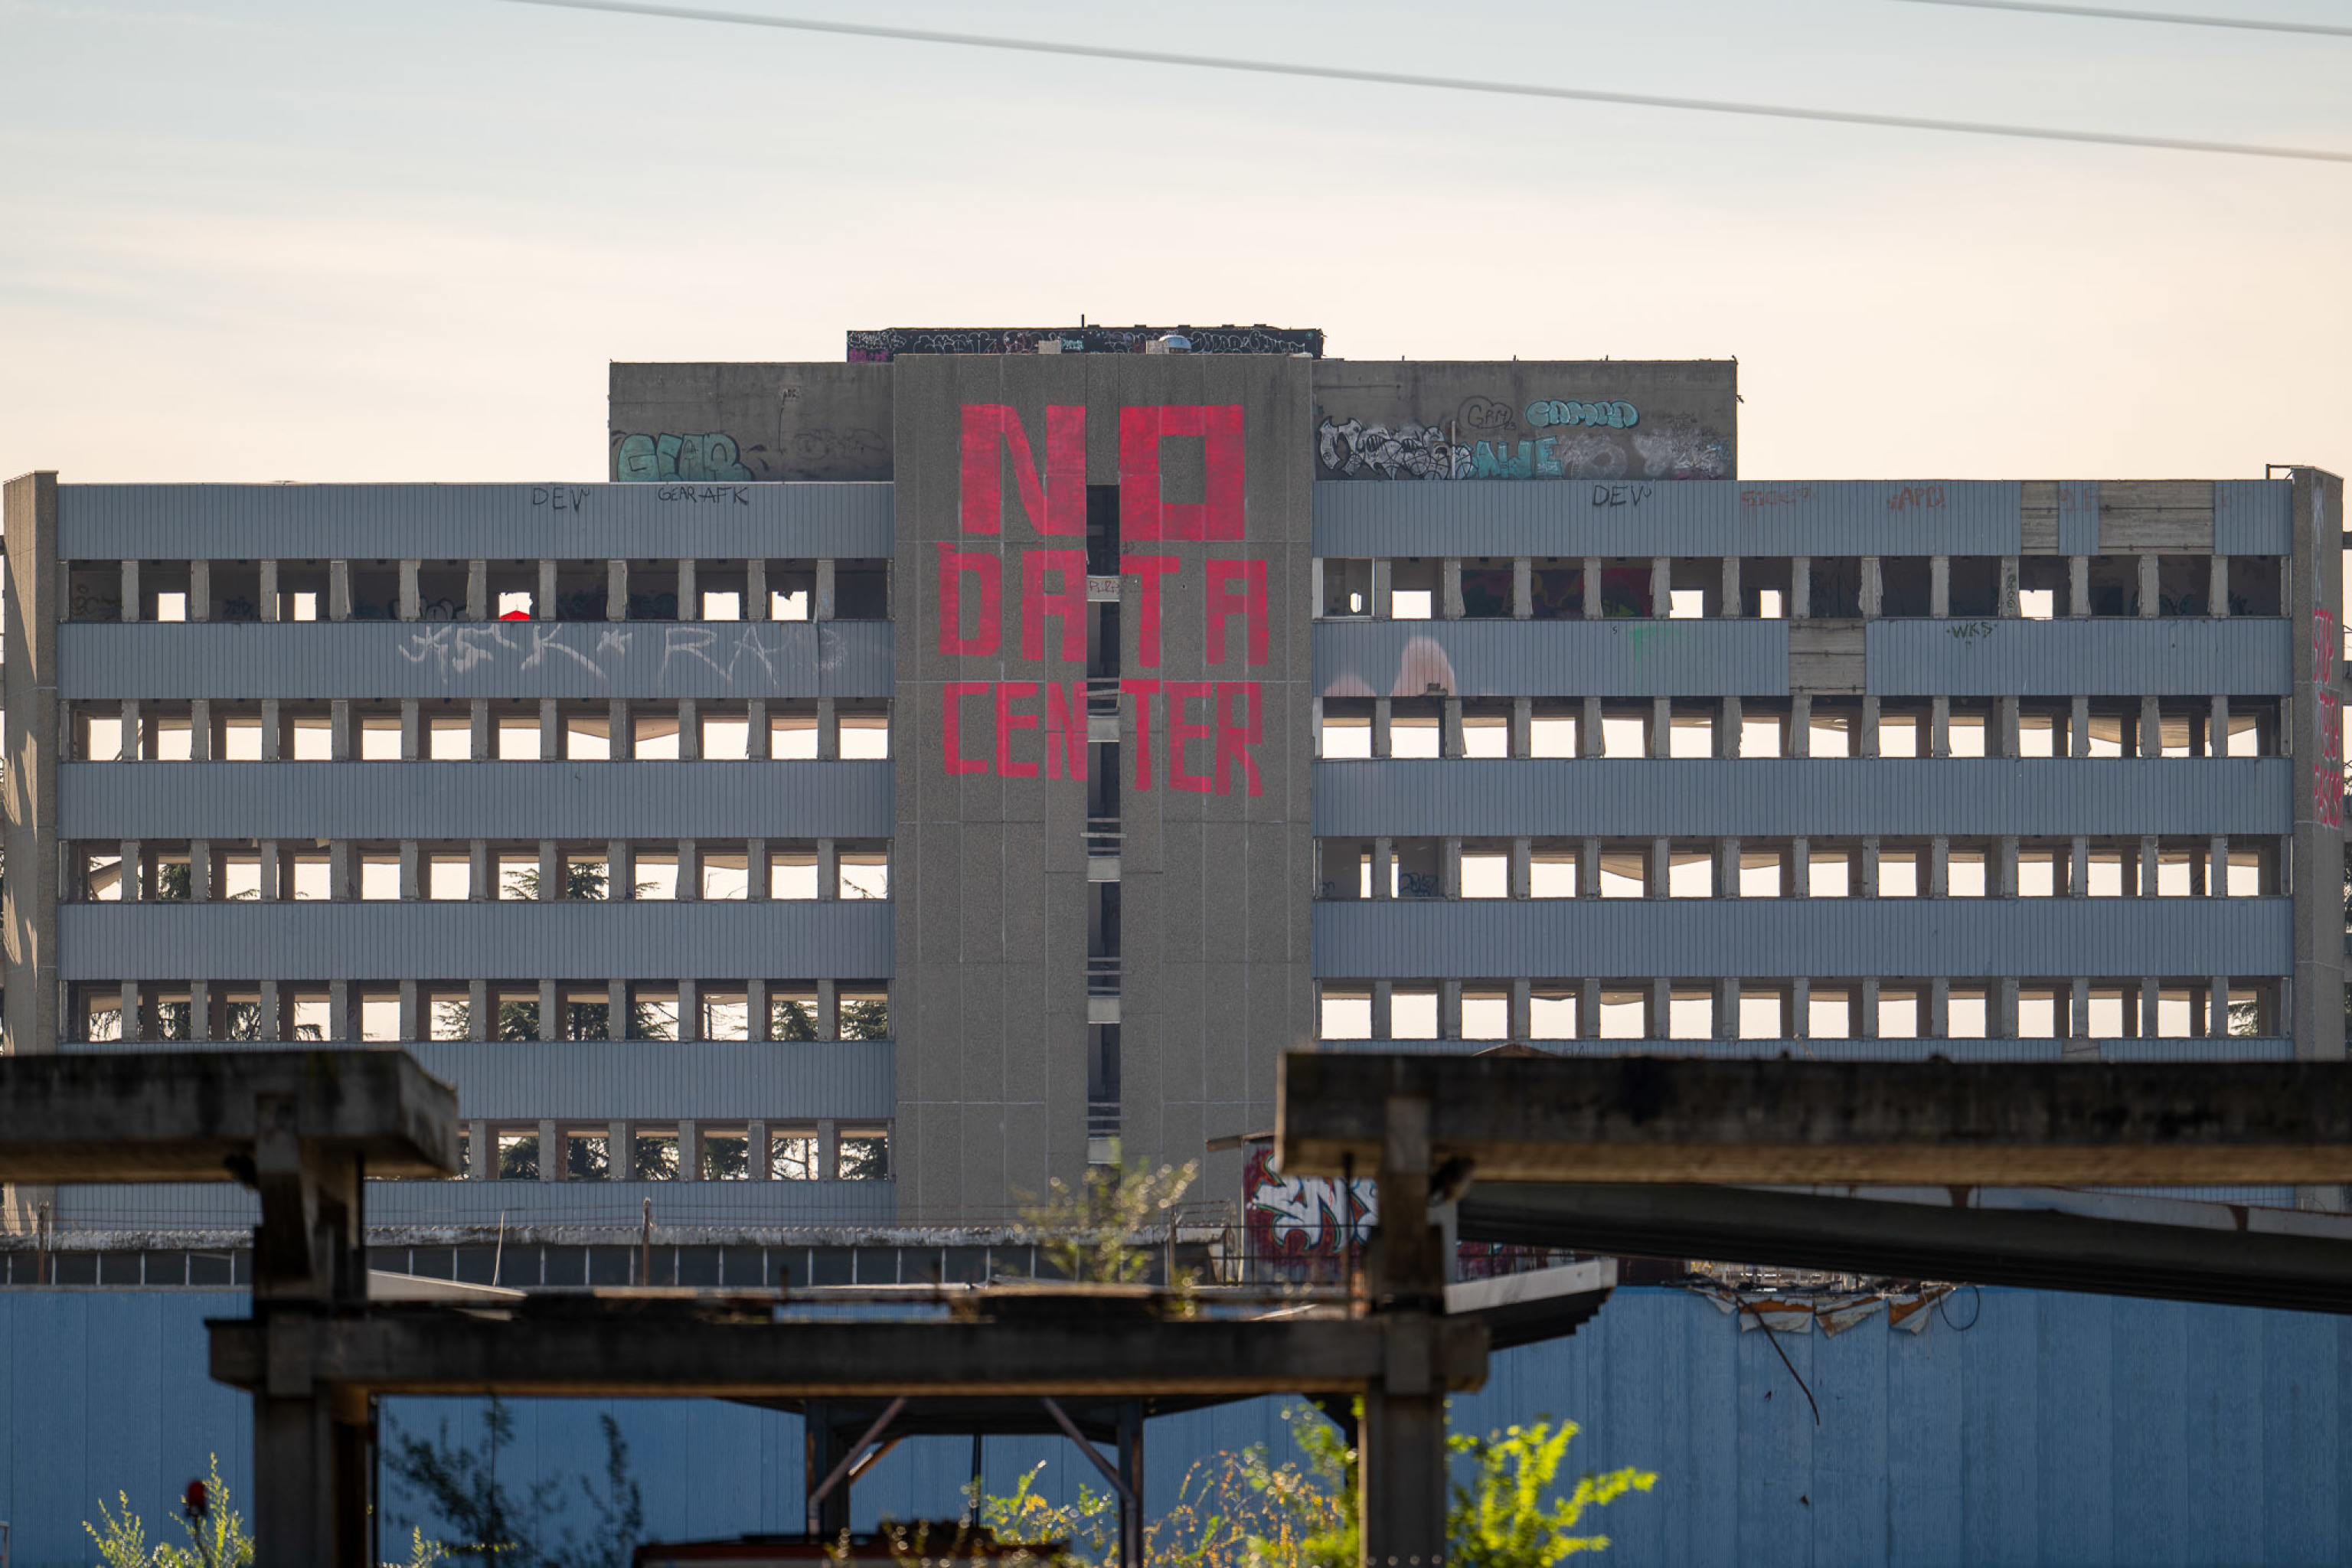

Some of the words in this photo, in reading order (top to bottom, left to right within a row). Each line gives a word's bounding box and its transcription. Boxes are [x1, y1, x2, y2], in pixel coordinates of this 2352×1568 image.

[961, 403, 1245, 541] NO
[938, 542, 1269, 668] DATA
[942, 679, 1263, 797] CENTER
